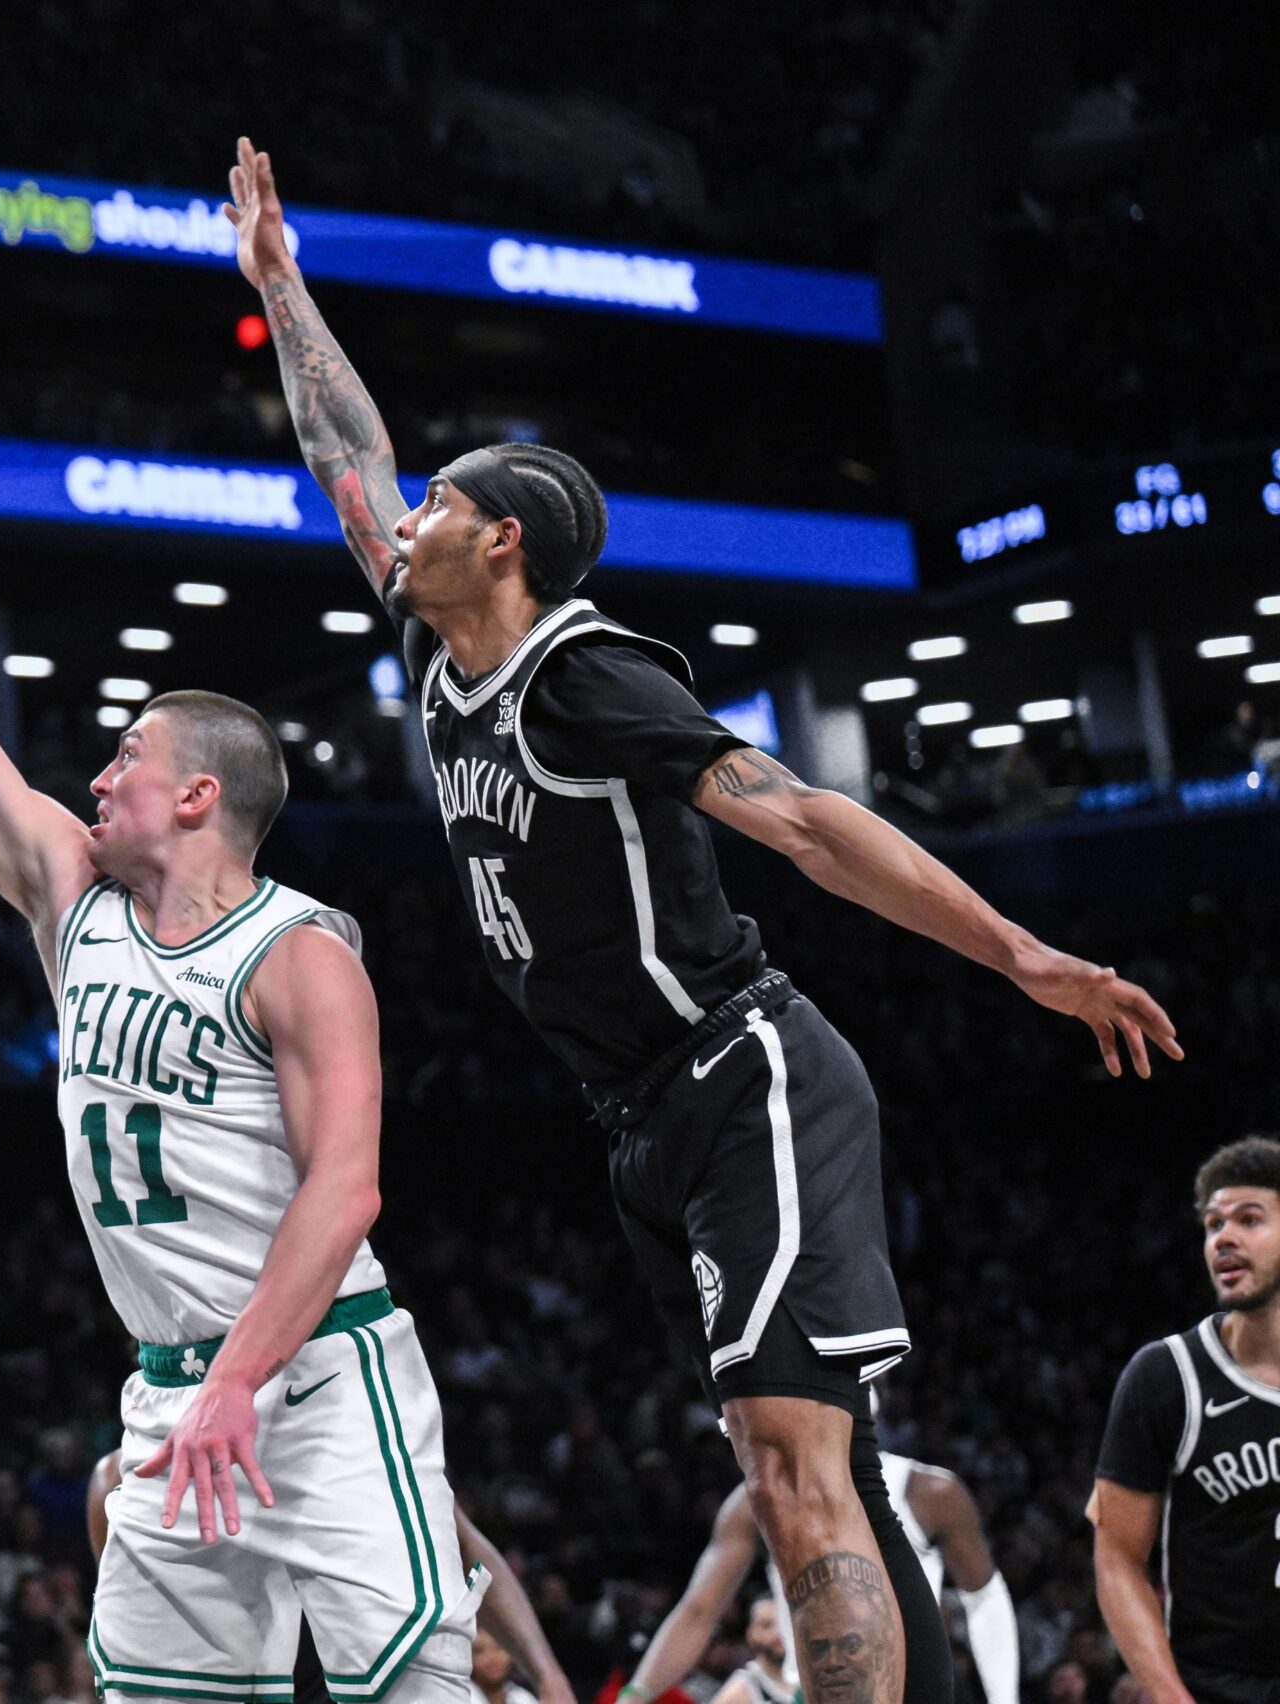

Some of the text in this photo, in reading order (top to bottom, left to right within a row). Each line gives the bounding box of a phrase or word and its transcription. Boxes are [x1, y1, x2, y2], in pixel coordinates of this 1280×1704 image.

[468, 857, 534, 960] 45
[176, 966, 225, 990] Amica
[81, 1102, 188, 1228] 11
